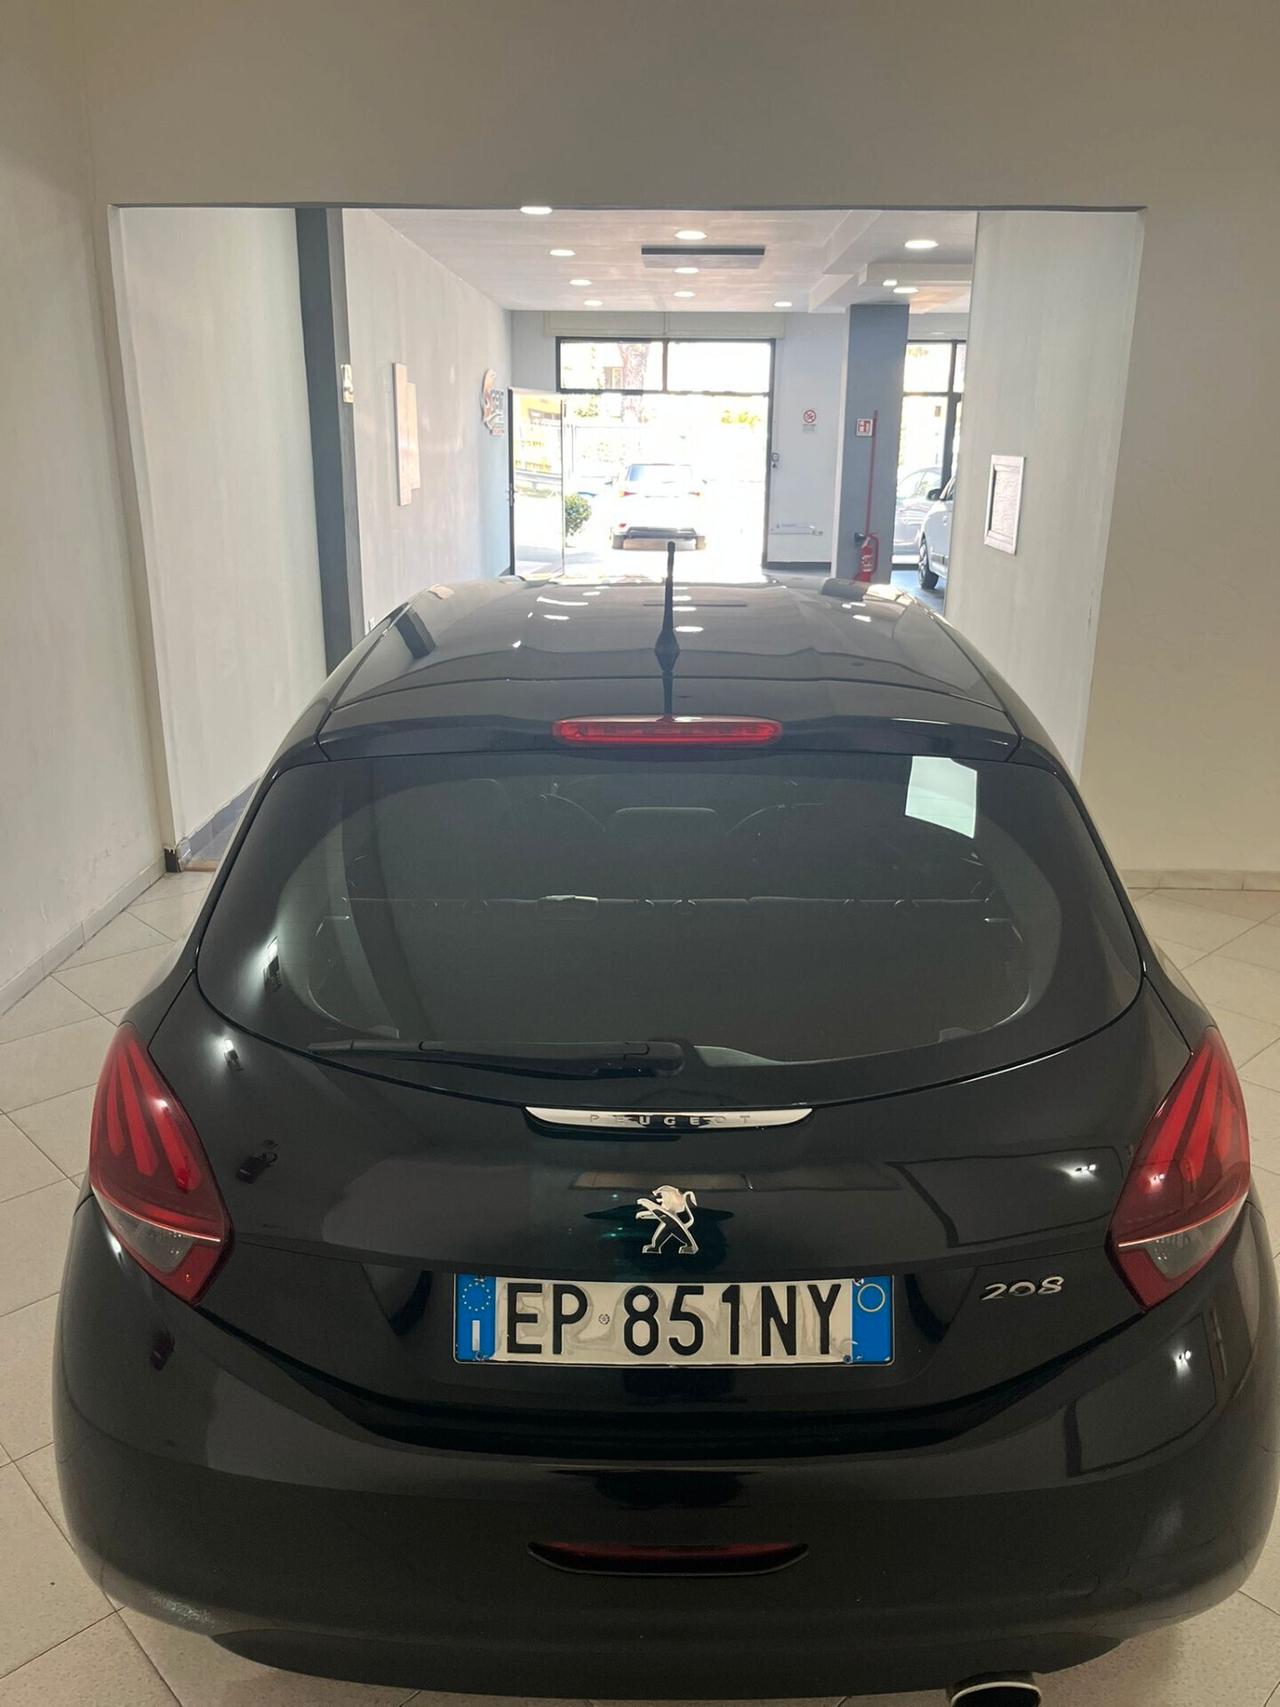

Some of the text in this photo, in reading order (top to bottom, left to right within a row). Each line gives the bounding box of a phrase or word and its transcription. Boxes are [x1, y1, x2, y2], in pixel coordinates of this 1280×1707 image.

[981, 1275, 1065, 1301] 208
[506, 1282, 842, 1357] EP 851NY
